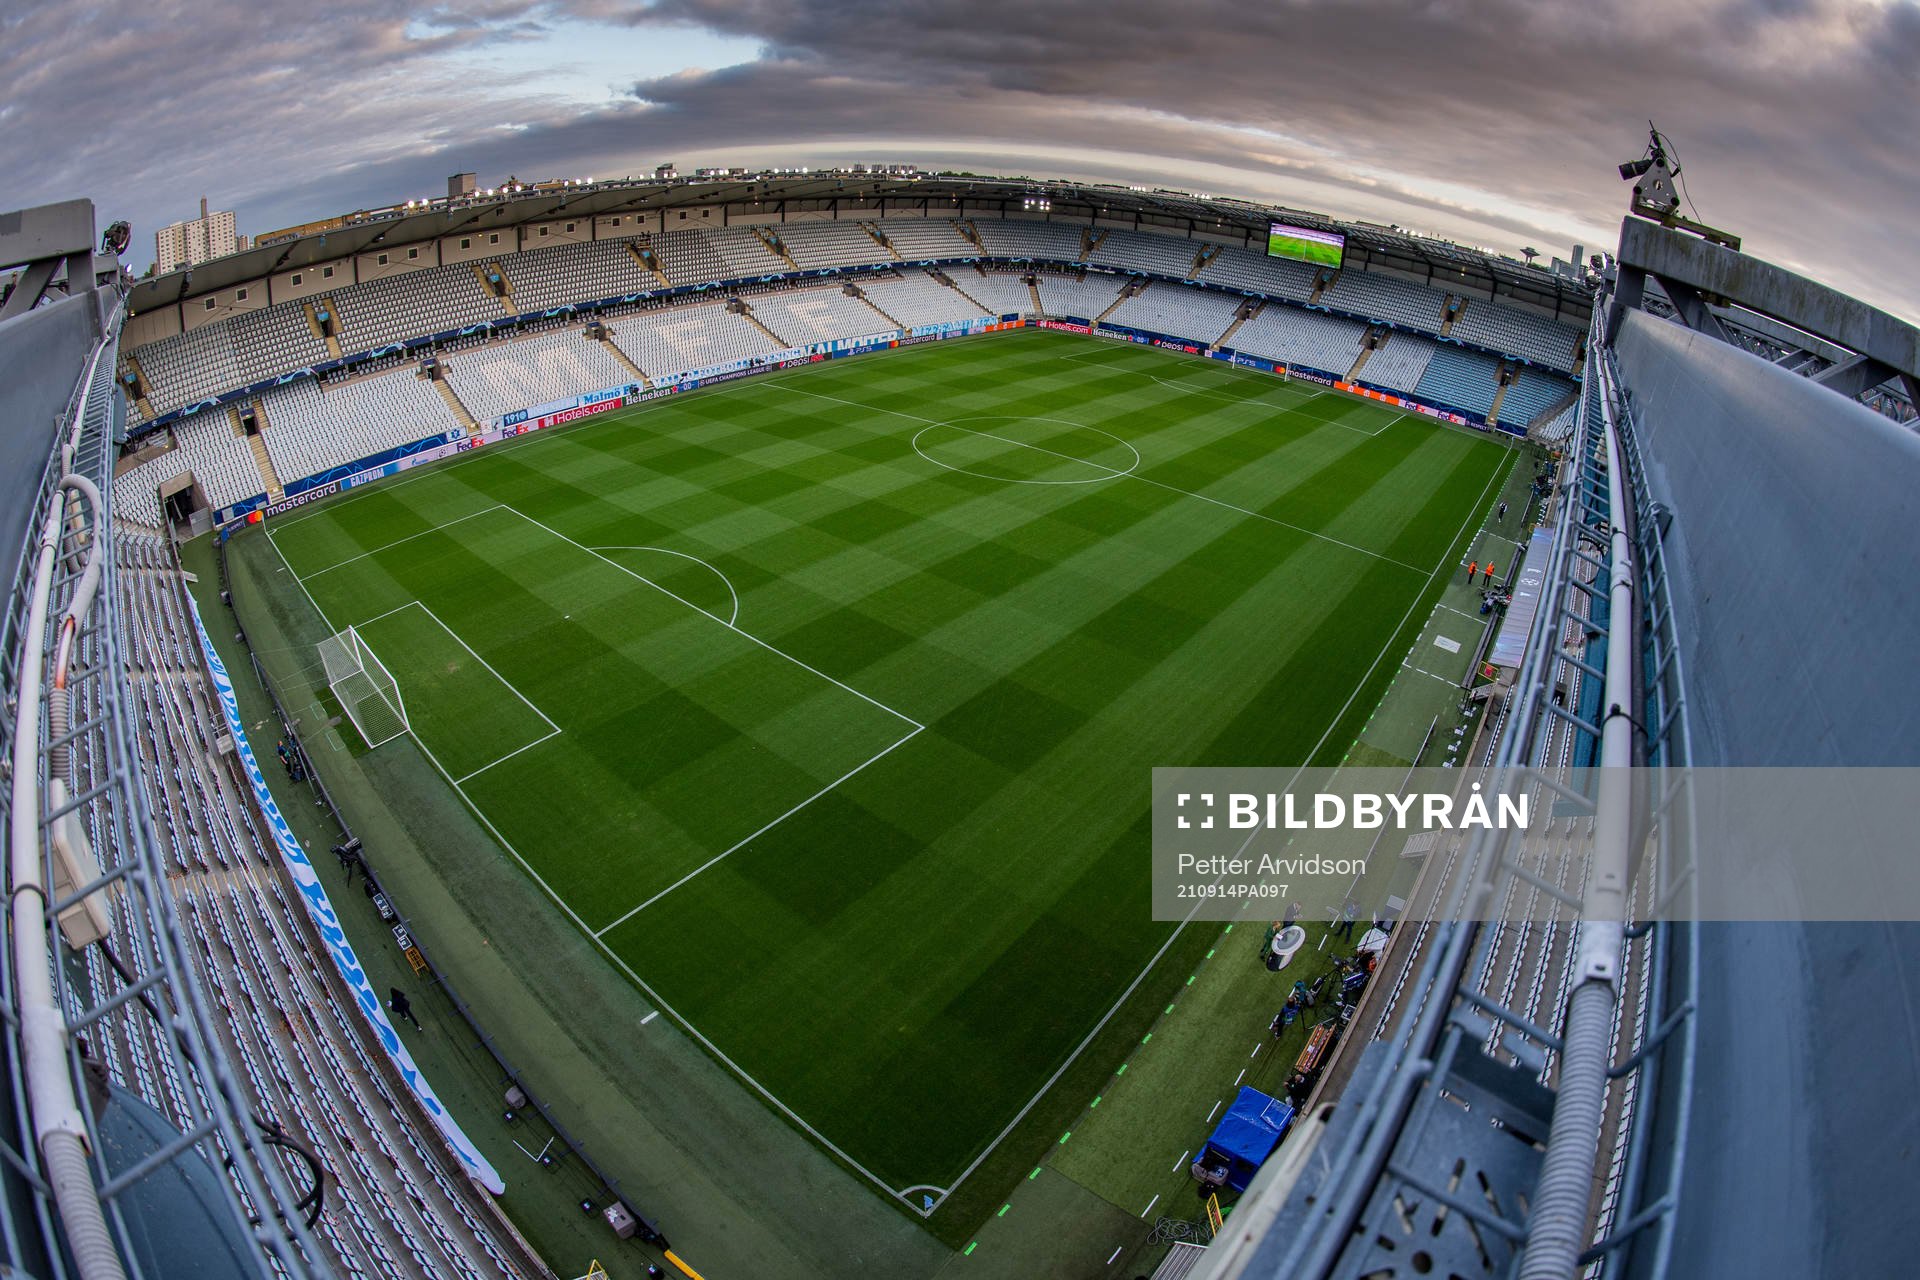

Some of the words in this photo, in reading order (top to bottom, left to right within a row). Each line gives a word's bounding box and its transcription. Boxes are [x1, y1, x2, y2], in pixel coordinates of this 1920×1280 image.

[1048, 321, 1088, 334] Hotels.com
[1093, 328, 1127, 341] Heineken
[899, 333, 936, 346] mastercard
[1161, 341, 1184, 352] pepsi
[787, 354, 811, 369] pepsi
[705, 377, 719, 386] UEFA
[719, 370, 747, 382] CHAMPIONS
[747, 366, 766, 376] LEAGUE
[1288, 369, 1332, 386] mastercard
[584, 387, 621, 405] Malmö
[625, 388, 671, 406] Heineken
[557, 400, 616, 425] Hotels.com
[1404, 401, 1426, 414] FedEx
[1437, 410, 1460, 425] FedEx
[502, 424, 529, 439] FedEx
[457, 437, 485, 454] FedEx
[350, 466, 385, 488] GAZPROM
[266, 482, 337, 518] mastercard
